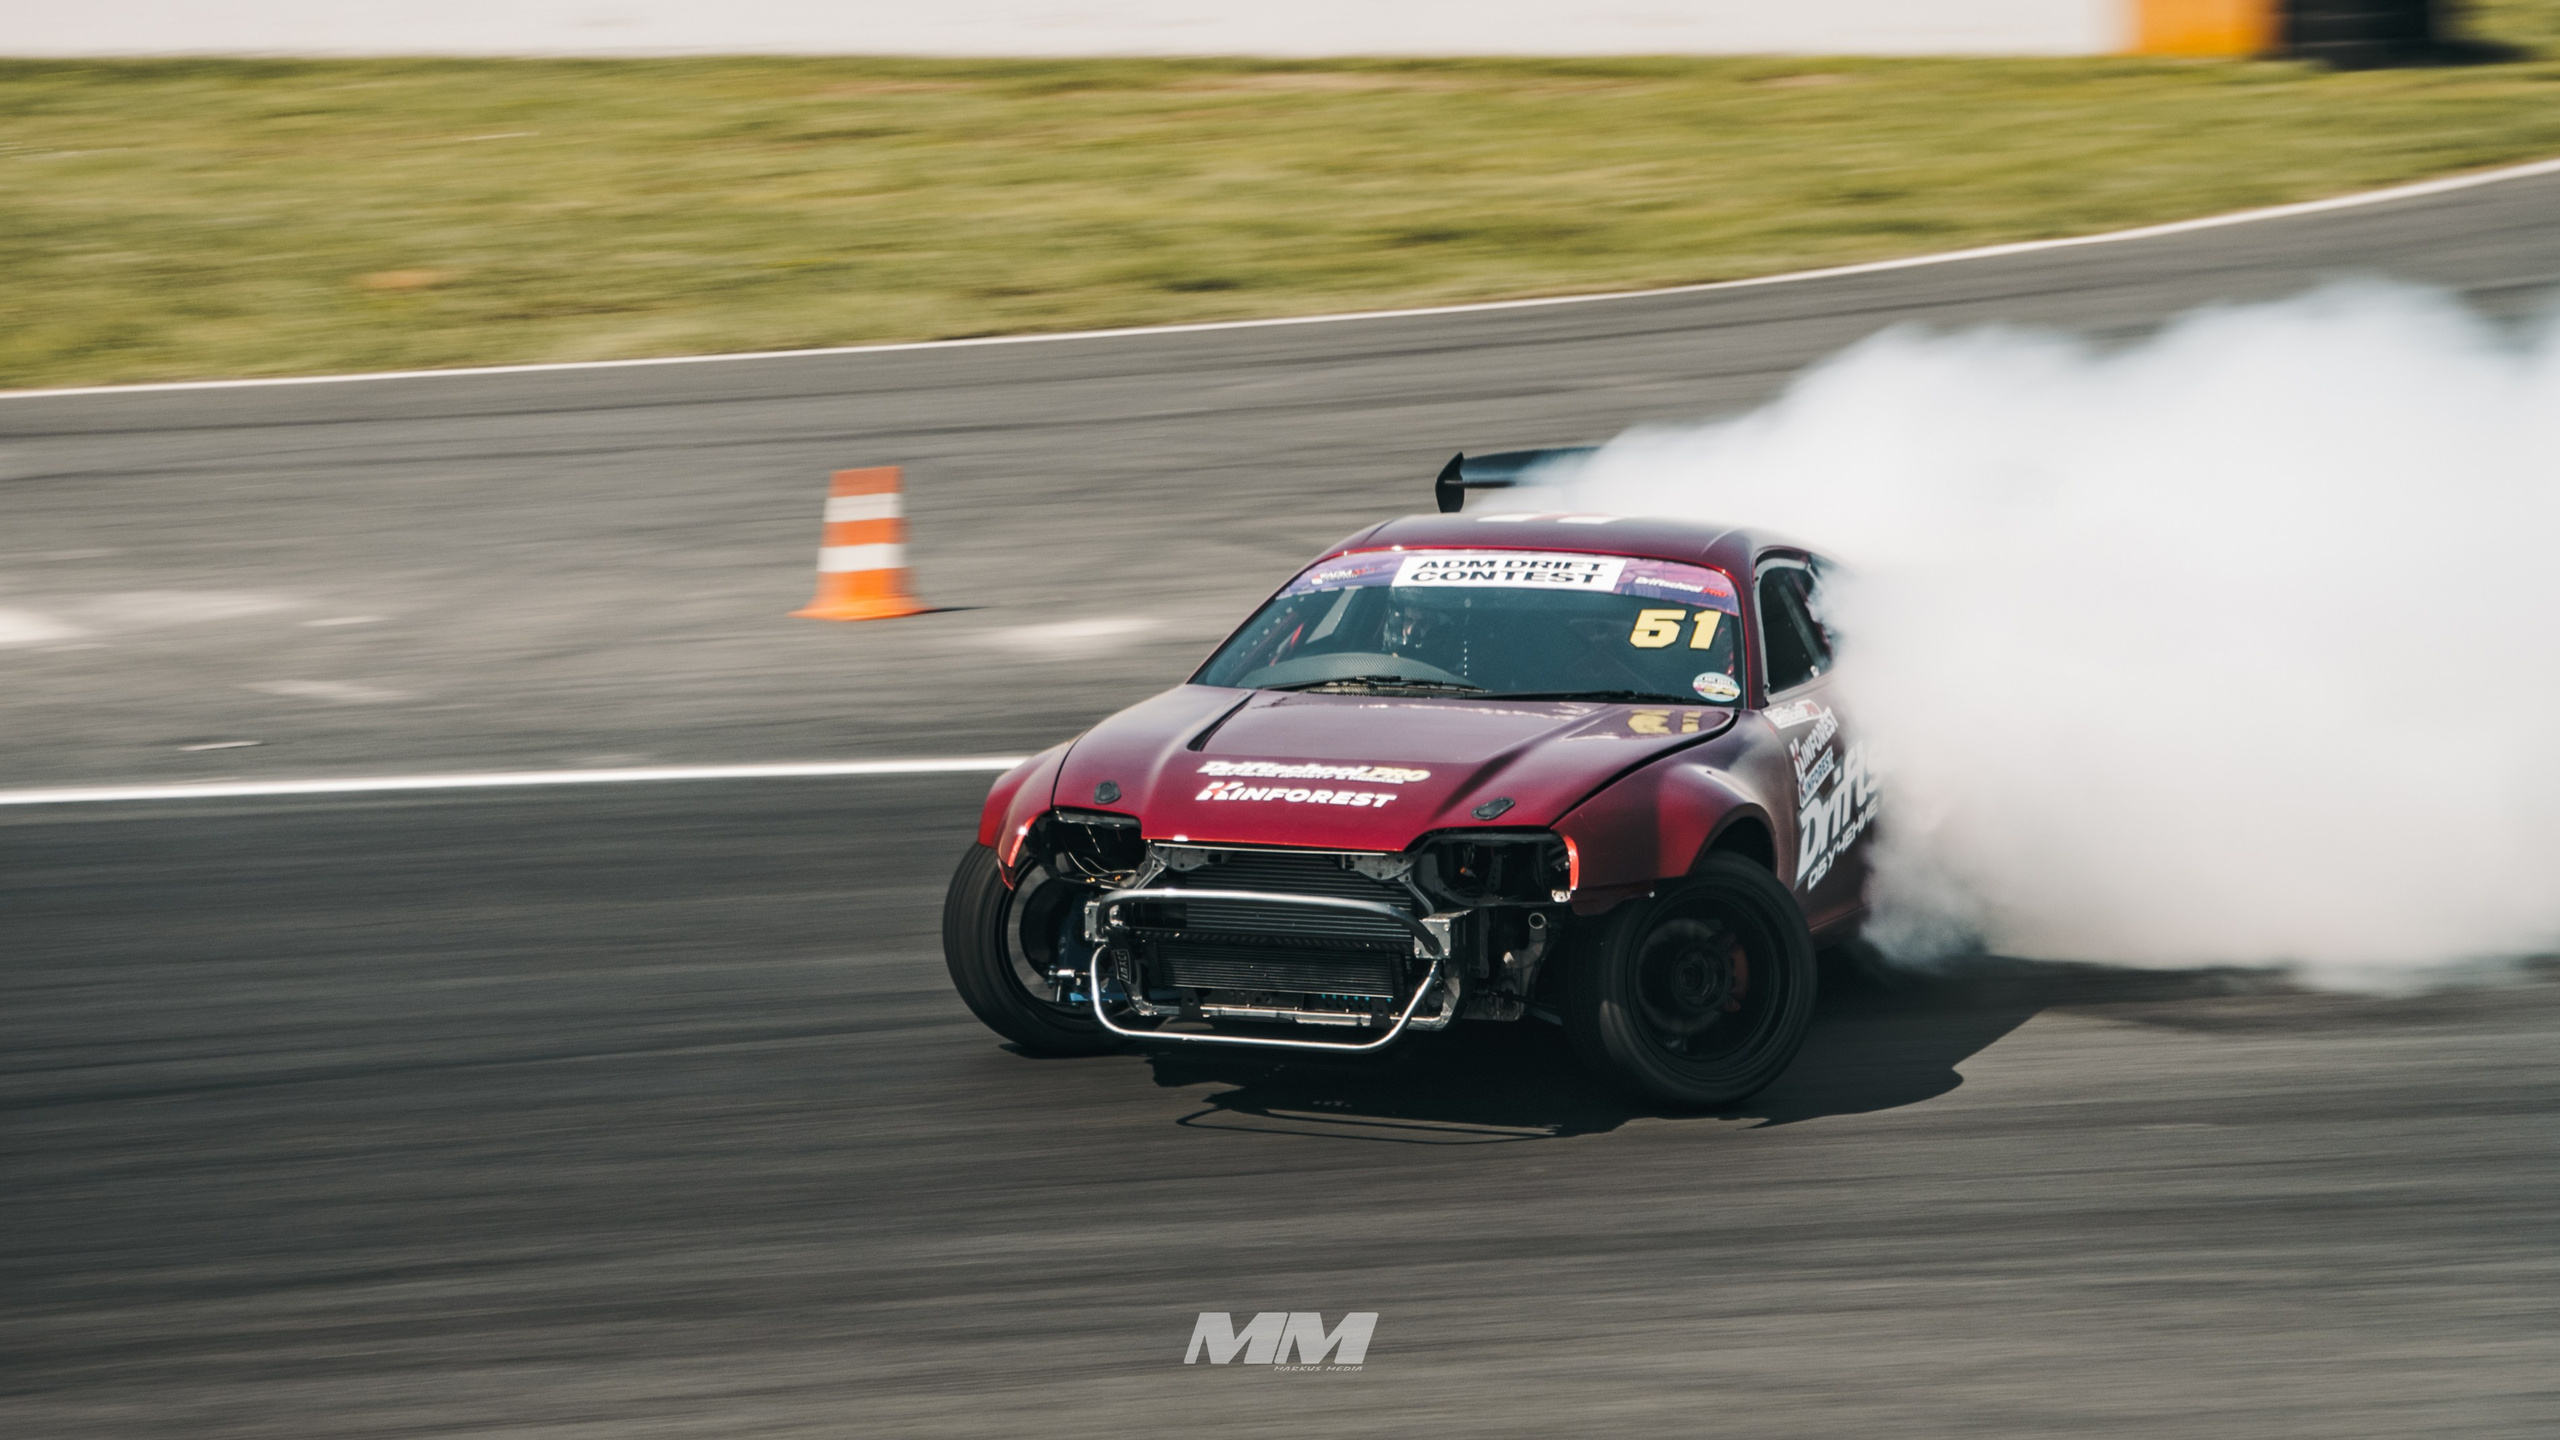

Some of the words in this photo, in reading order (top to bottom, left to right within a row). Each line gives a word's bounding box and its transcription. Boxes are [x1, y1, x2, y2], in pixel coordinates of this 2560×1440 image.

[1410, 570, 1604, 584] CONTEST
[1418, 559, 1498, 570] ADM
[1503, 559, 1609, 572] DRIFT
[1629, 608, 1722, 651] 51
[1789, 706, 1838, 780] KINFOREST
[1195, 781, 1398, 808] KINFOREST
